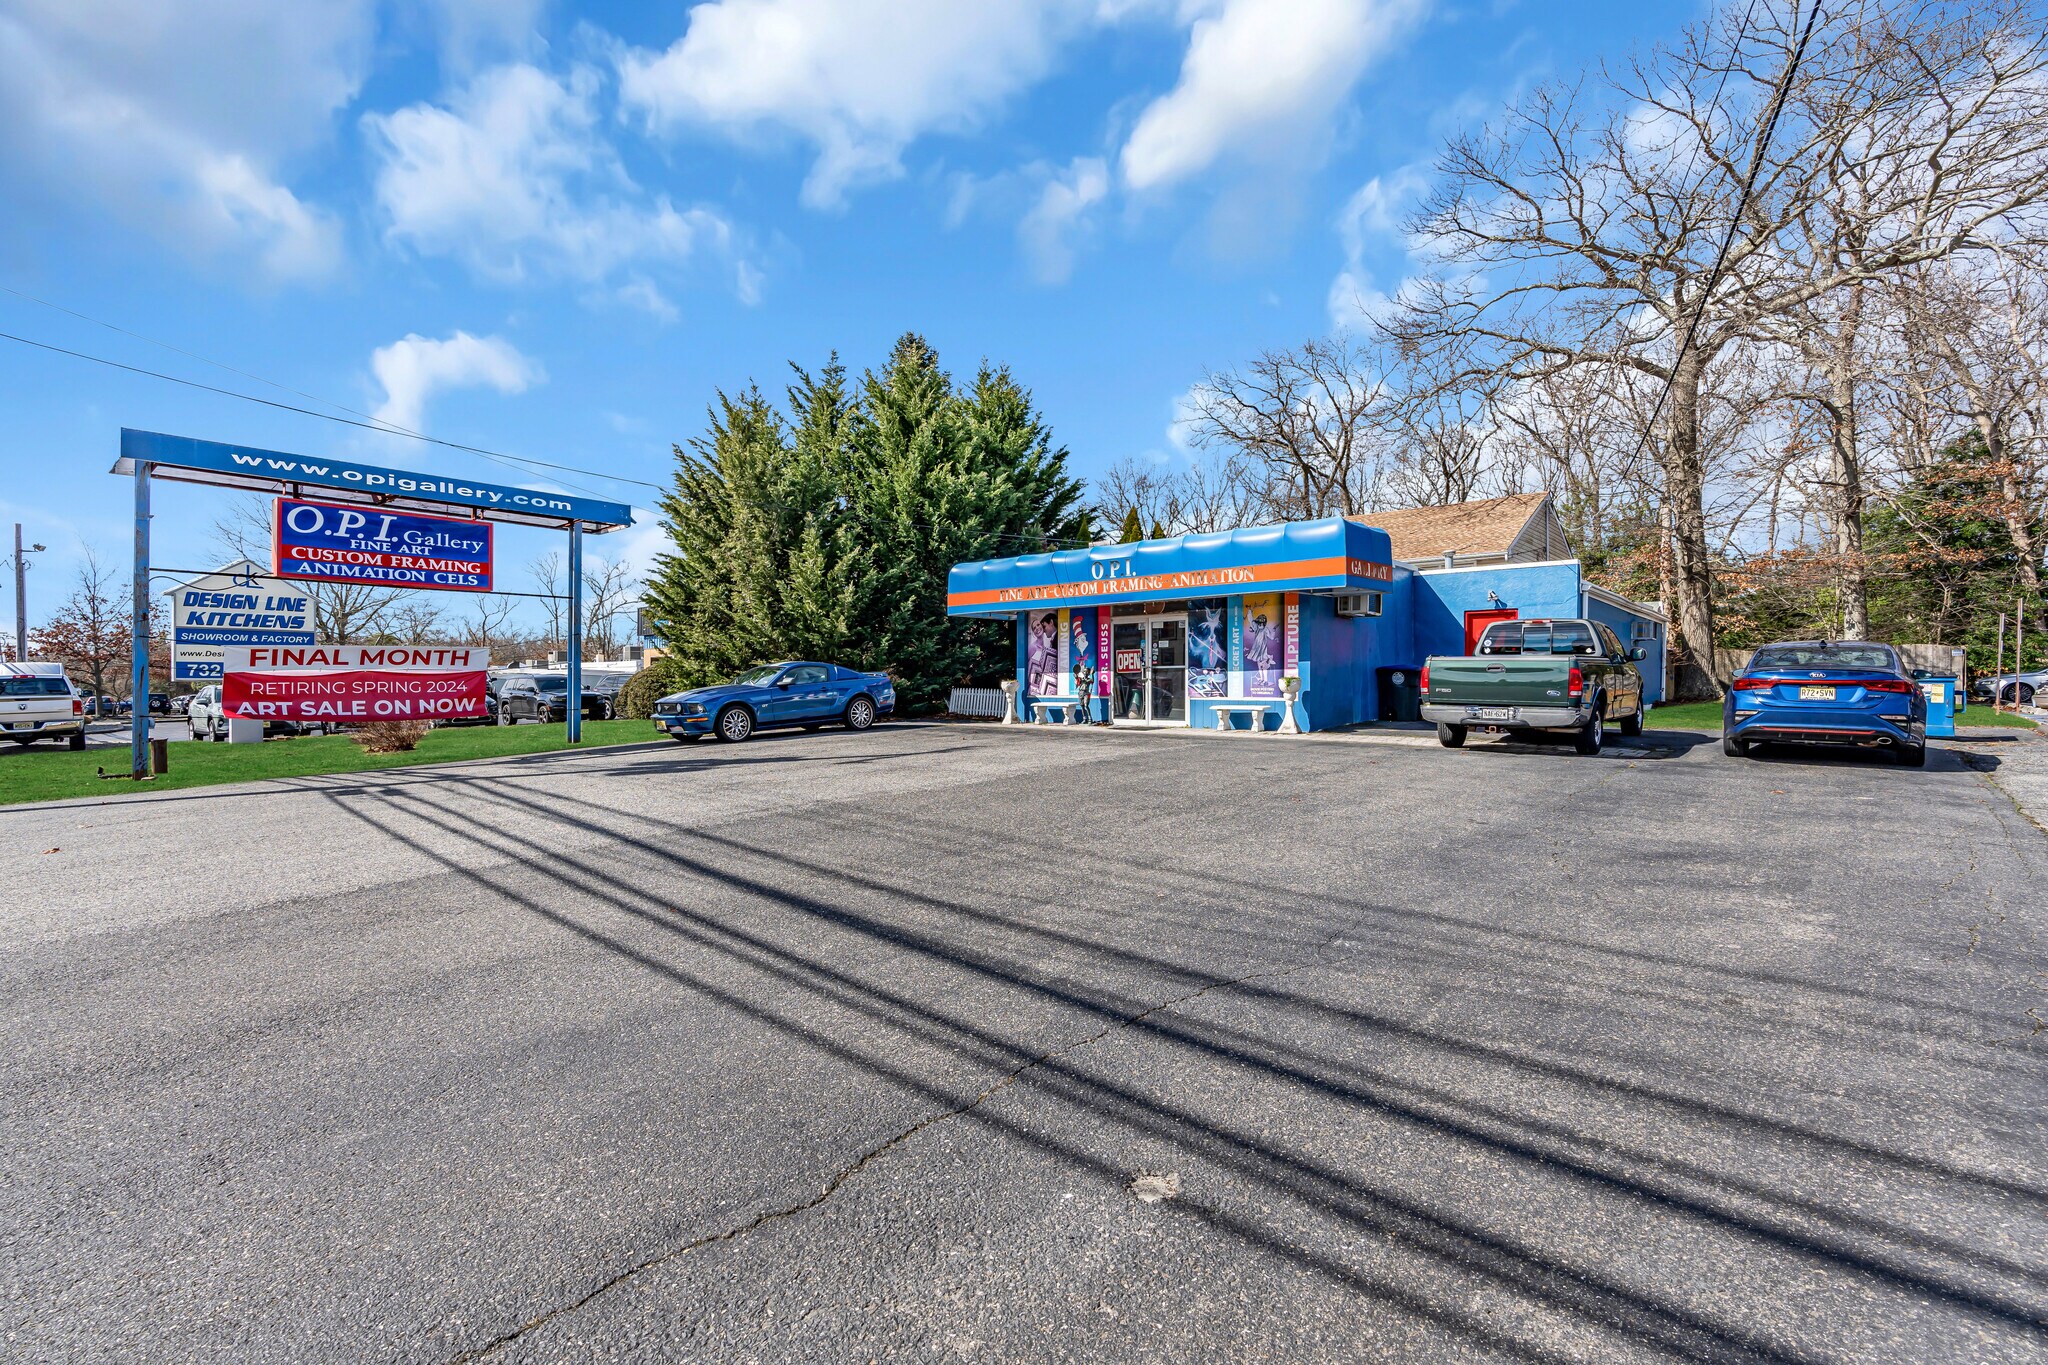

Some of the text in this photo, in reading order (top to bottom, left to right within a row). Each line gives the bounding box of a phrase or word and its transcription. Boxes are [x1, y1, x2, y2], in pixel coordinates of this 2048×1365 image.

[231, 453, 572, 511] www.opigallery.com
[287, 506, 484, 553] O.P.I. Gallery
[350, 539, 432, 556] FINE ART
[291, 547, 481, 574] CUSTOM FRAMING
[296, 562, 478, 586] ANIMATION CELS
[183, 591, 307, 612] DESIGN LINE
[999, 588, 1024, 601] FINE
[186, 611, 306, 629] KITCHENS
[181, 632, 310, 644] SHOWROOM & FACTORY
[1232, 627, 1240, 644] ART
[249, 648, 470, 667] FINAL MONTH
[1100, 623, 1109, 683] DR. SEUSS
[1117, 653, 1142, 670] OPEN
[1232, 644, 1240, 672] ECRET
[250, 680, 468, 695] RETIRING SPRING 2024
[236, 697, 477, 716] ART SALE ON NOW
